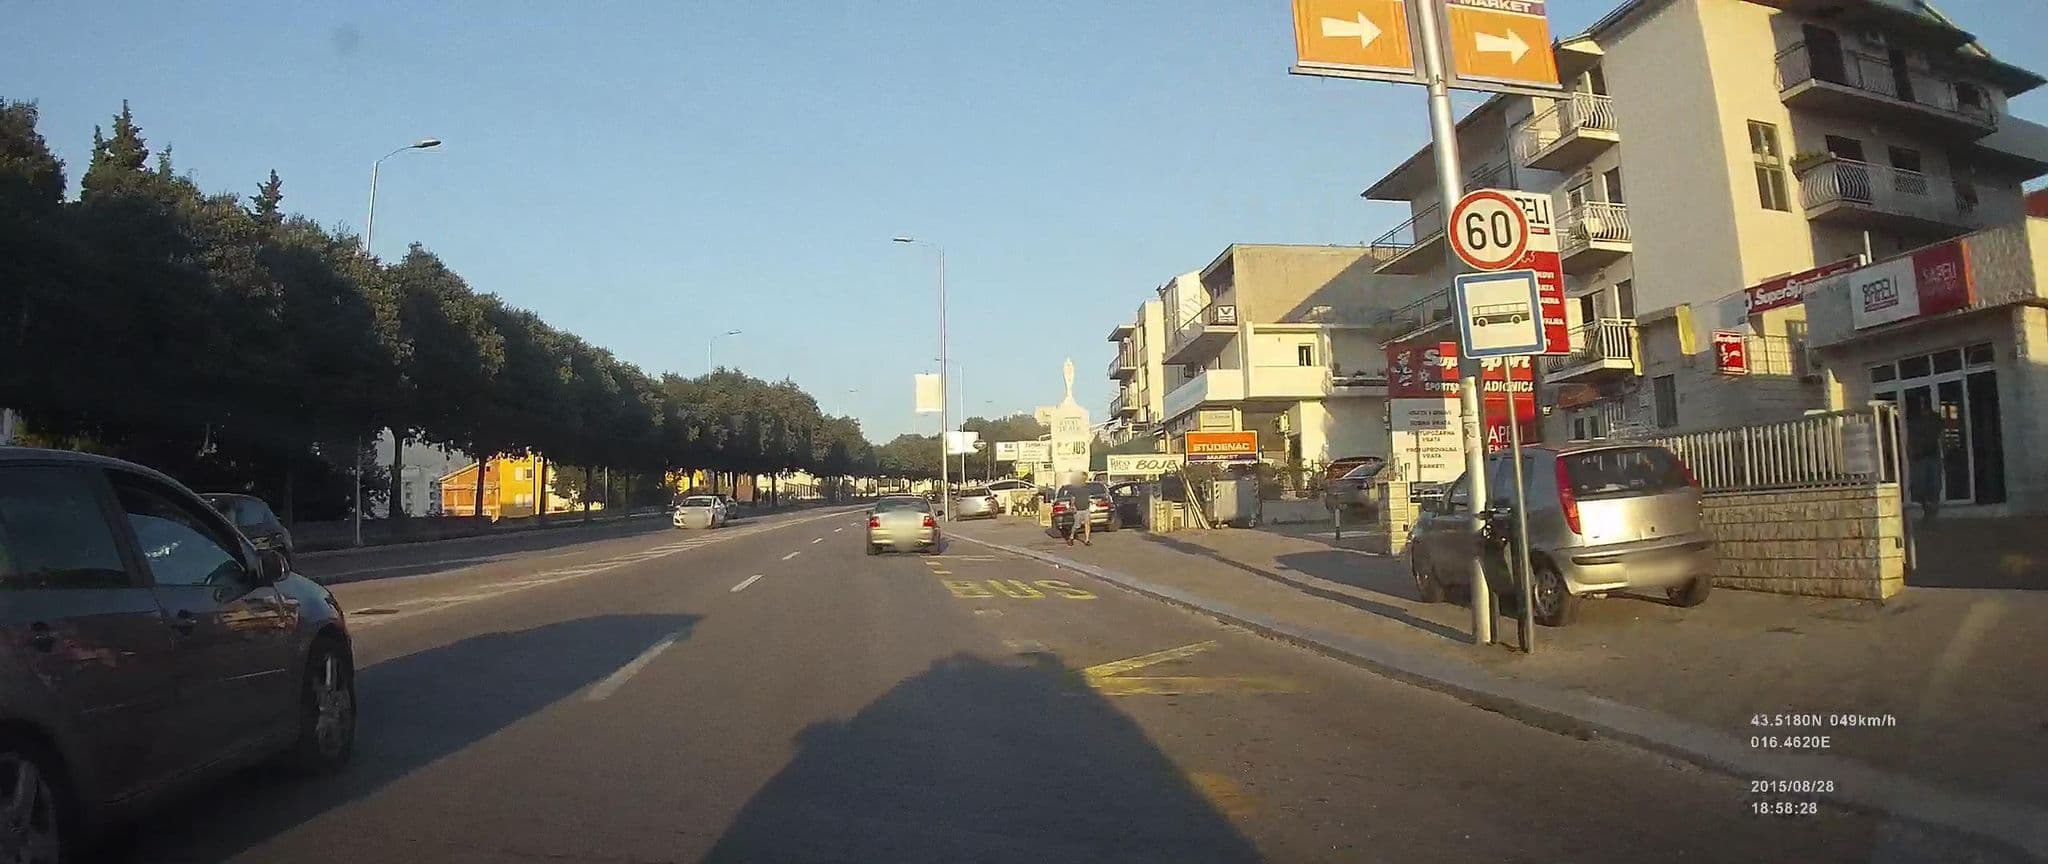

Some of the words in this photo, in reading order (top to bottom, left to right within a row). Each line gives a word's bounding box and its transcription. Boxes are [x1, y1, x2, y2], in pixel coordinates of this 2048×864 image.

[1460, 0, 1532, 13] MARKET
[1465, 210, 1513, 250] 60
[1193, 442, 1251, 452] STUDENAC
[941, 579, 1099, 600] BUS
